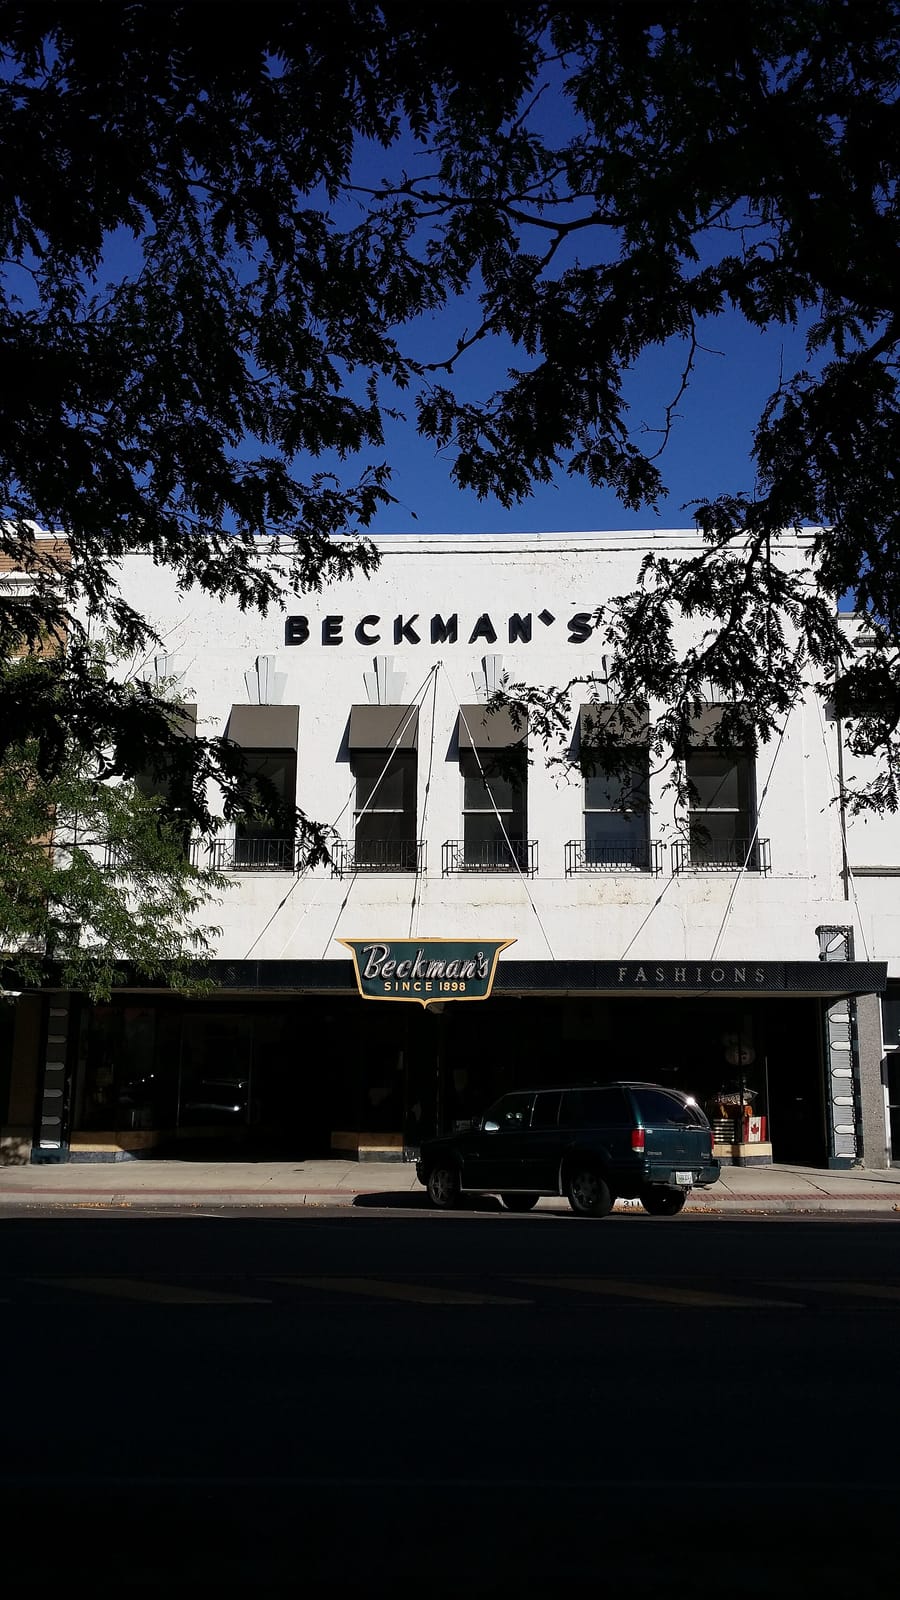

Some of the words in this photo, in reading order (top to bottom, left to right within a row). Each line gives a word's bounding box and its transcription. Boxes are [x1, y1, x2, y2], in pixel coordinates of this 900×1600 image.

[285, 609, 594, 646] BECKMAN'S
[361, 943, 490, 980] Beckman's
[383, 981, 433, 992] SINCE
[439, 981, 467, 992] 1898
[617, 967, 766, 983] FASHIONS
